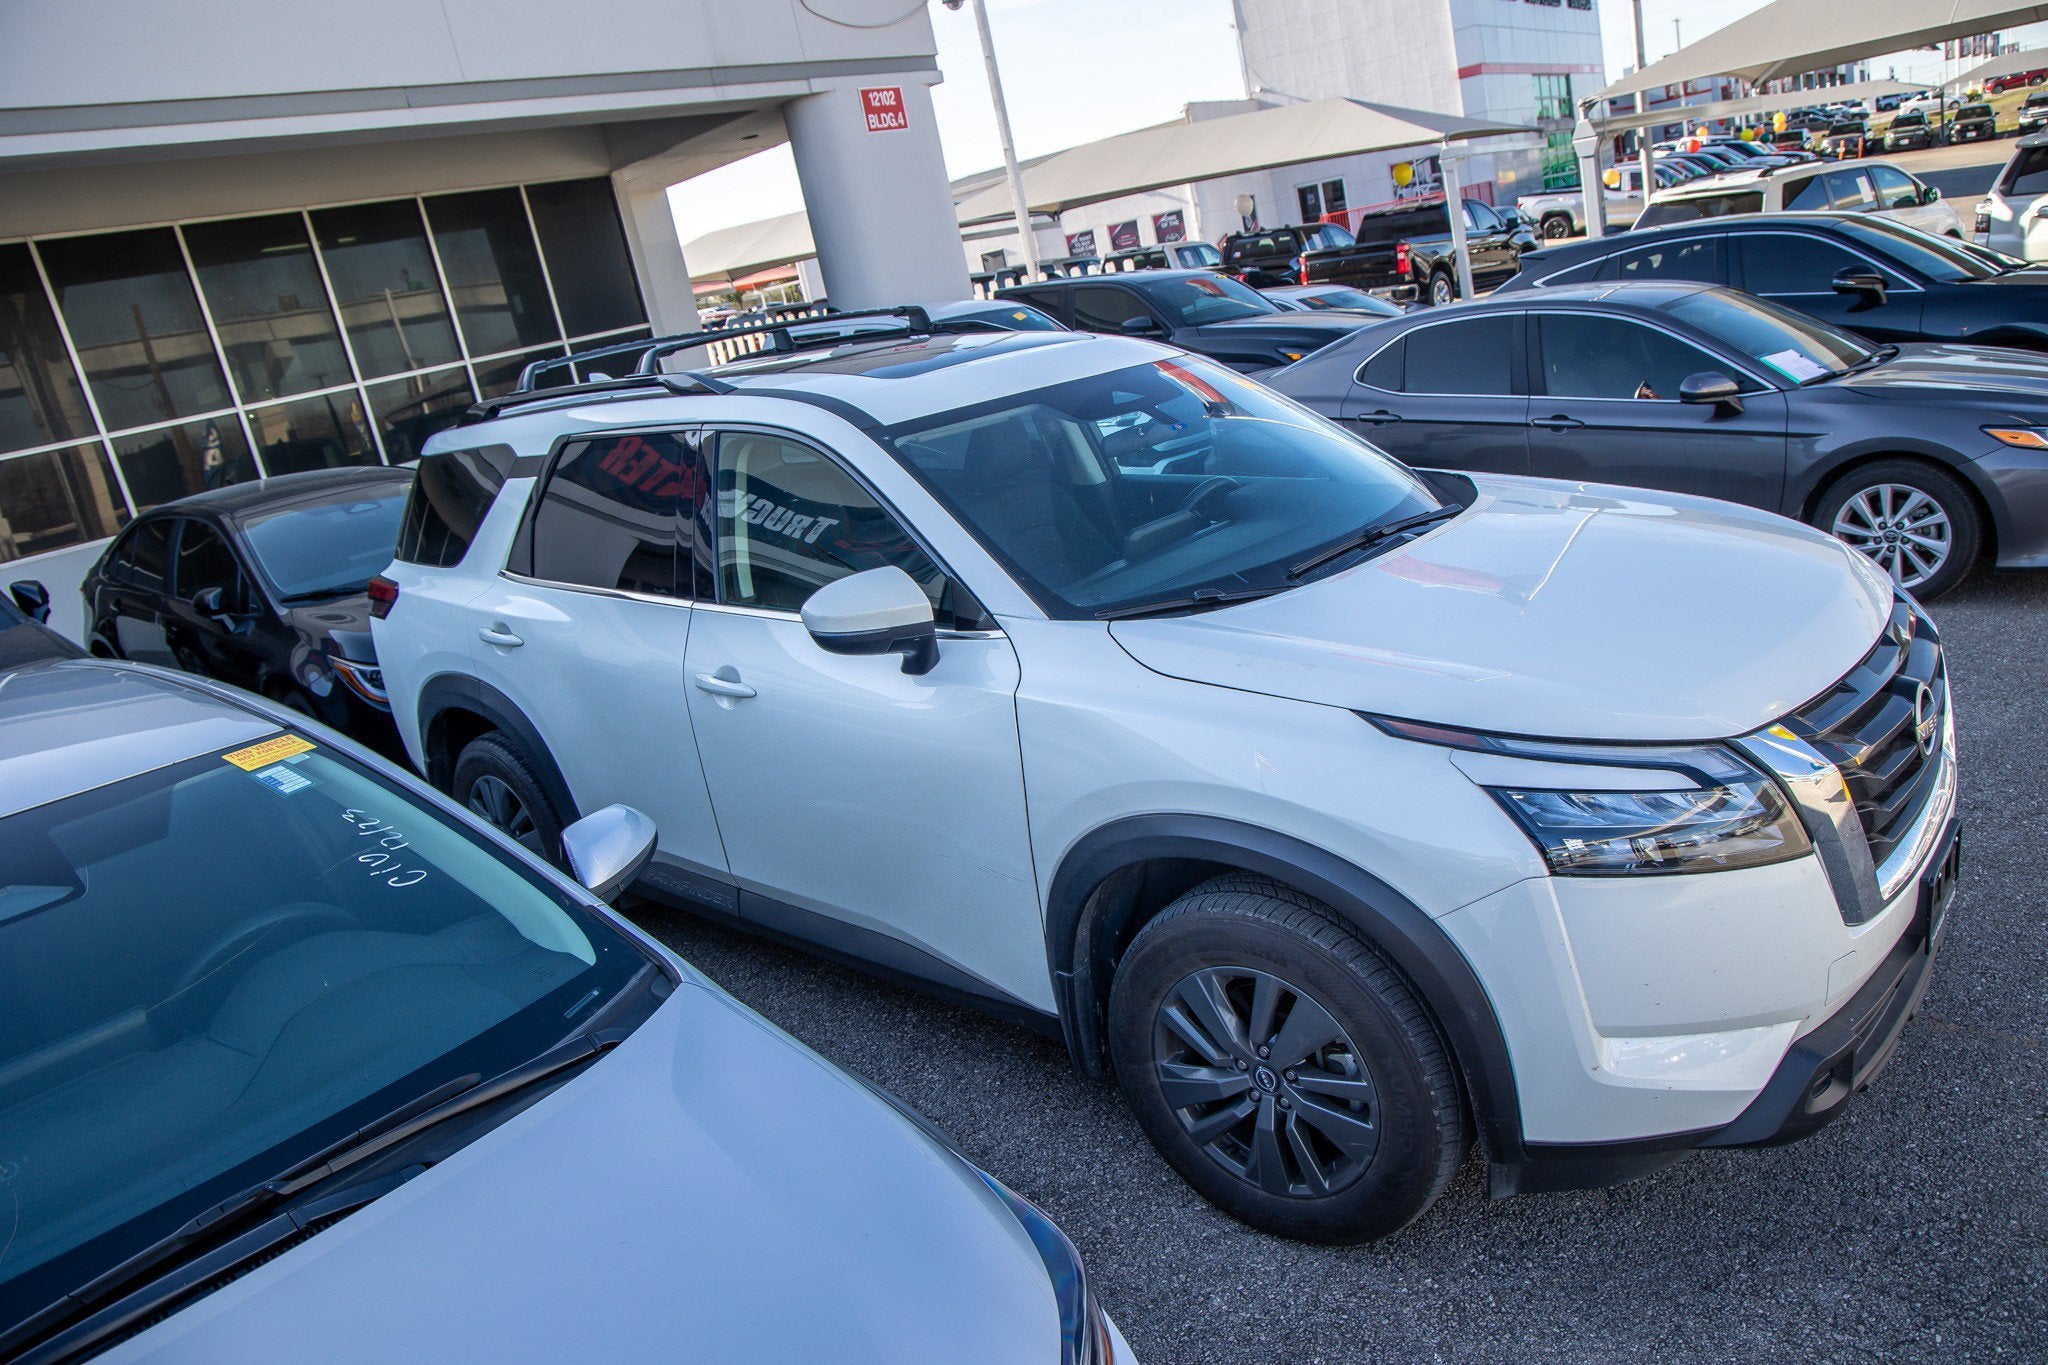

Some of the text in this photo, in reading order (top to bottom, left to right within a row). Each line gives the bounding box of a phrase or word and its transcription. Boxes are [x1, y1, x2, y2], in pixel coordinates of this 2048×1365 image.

[868, 90, 897, 107] 12102
[1169, 219, 1180, 227] THE
[227, 749, 253, 759] THIS
[253, 735, 293, 750] VEHICLE
[238, 740, 299, 762] NOT FOR SALE
[644, 866, 735, 911] PATHFINDER
